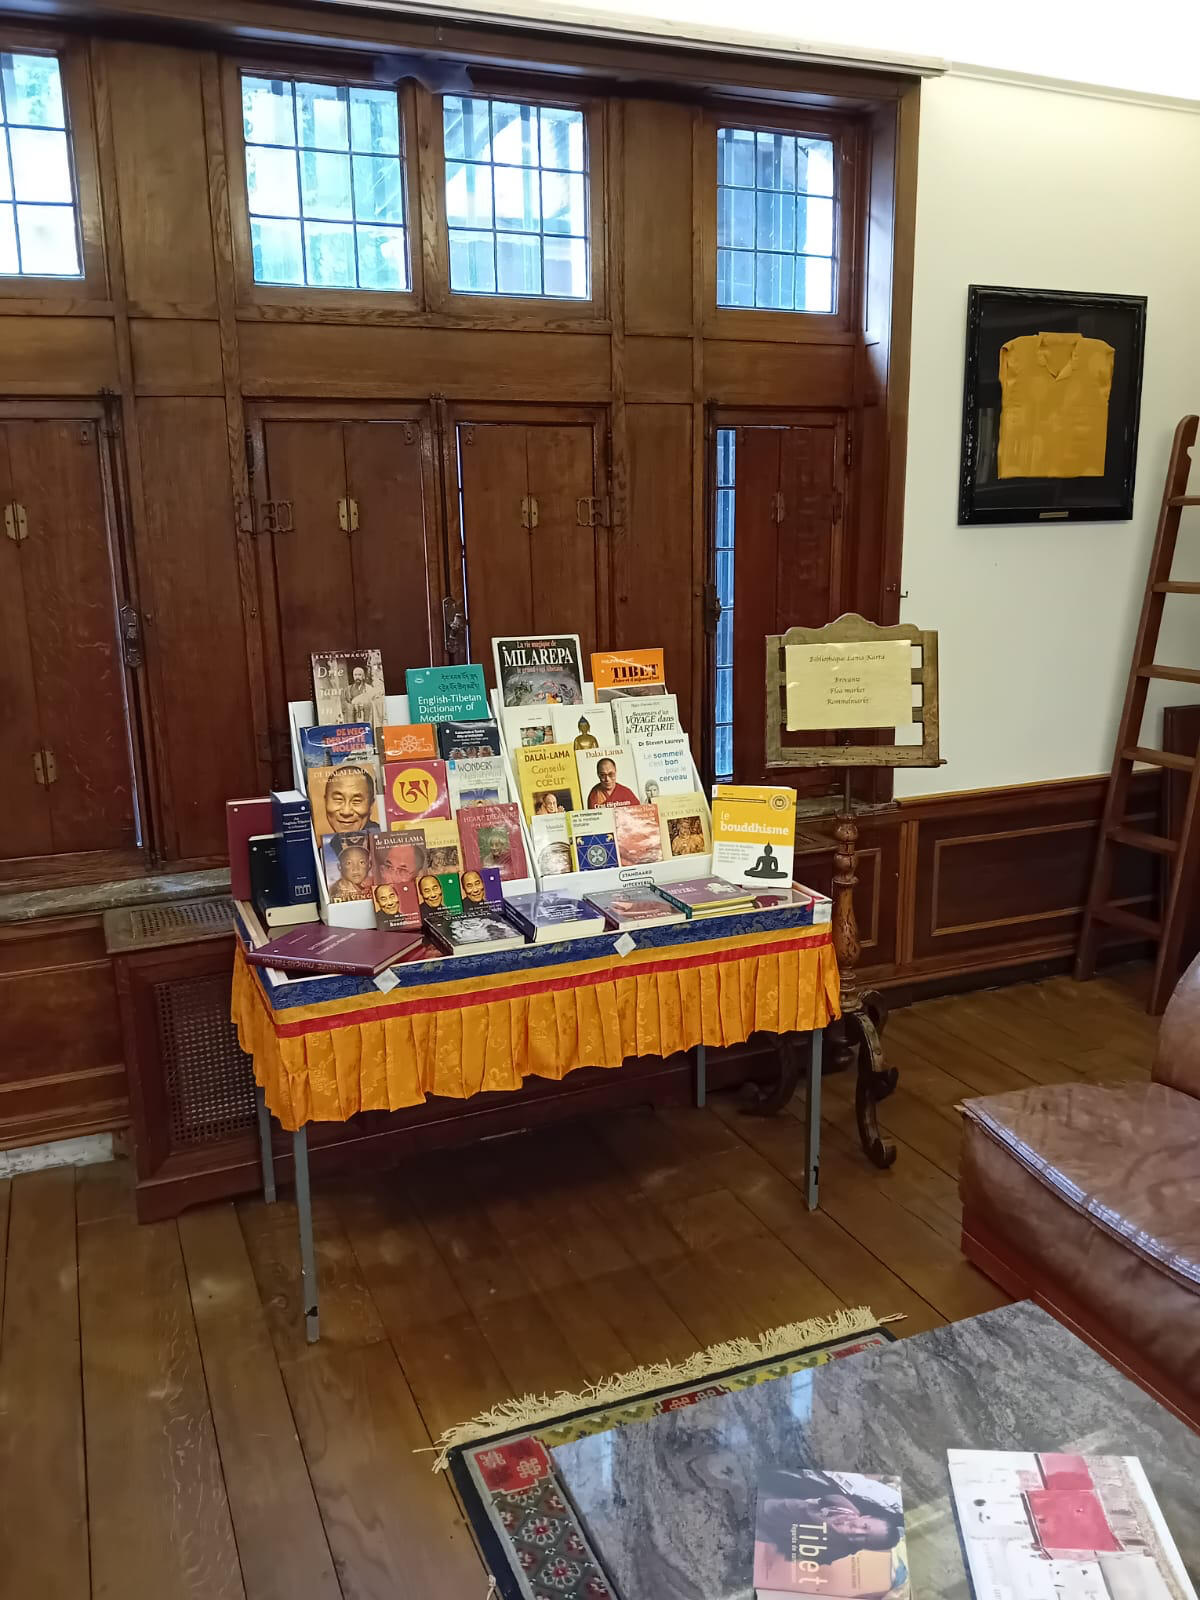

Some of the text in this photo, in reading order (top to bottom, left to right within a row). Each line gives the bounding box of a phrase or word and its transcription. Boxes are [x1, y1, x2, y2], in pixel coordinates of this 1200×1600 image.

[503, 647, 574, 667] MILAREPA
[318, 666, 344, 678] Drie
[611, 663, 659, 679] TIBET
[417, 693, 483, 706] English-Tibetan
[419, 701, 475, 714] Dictionary of
[420, 714, 454, 722] Modern
[625, 714, 675, 726] VOYAGE dans
[631, 722, 676, 734] TARTARIE
[524, 750, 570, 763] DALAI-LAMA
[604, 748, 624, 757] Lama
[653, 749, 684, 759] sommeil
[531, 763, 566, 774] Conseils
[659, 774, 688, 782] cerveau
[720, 810, 730, 820] le
[720, 820, 790, 836] bouddhisme
[798, 1521, 828, 1585] Tibet
